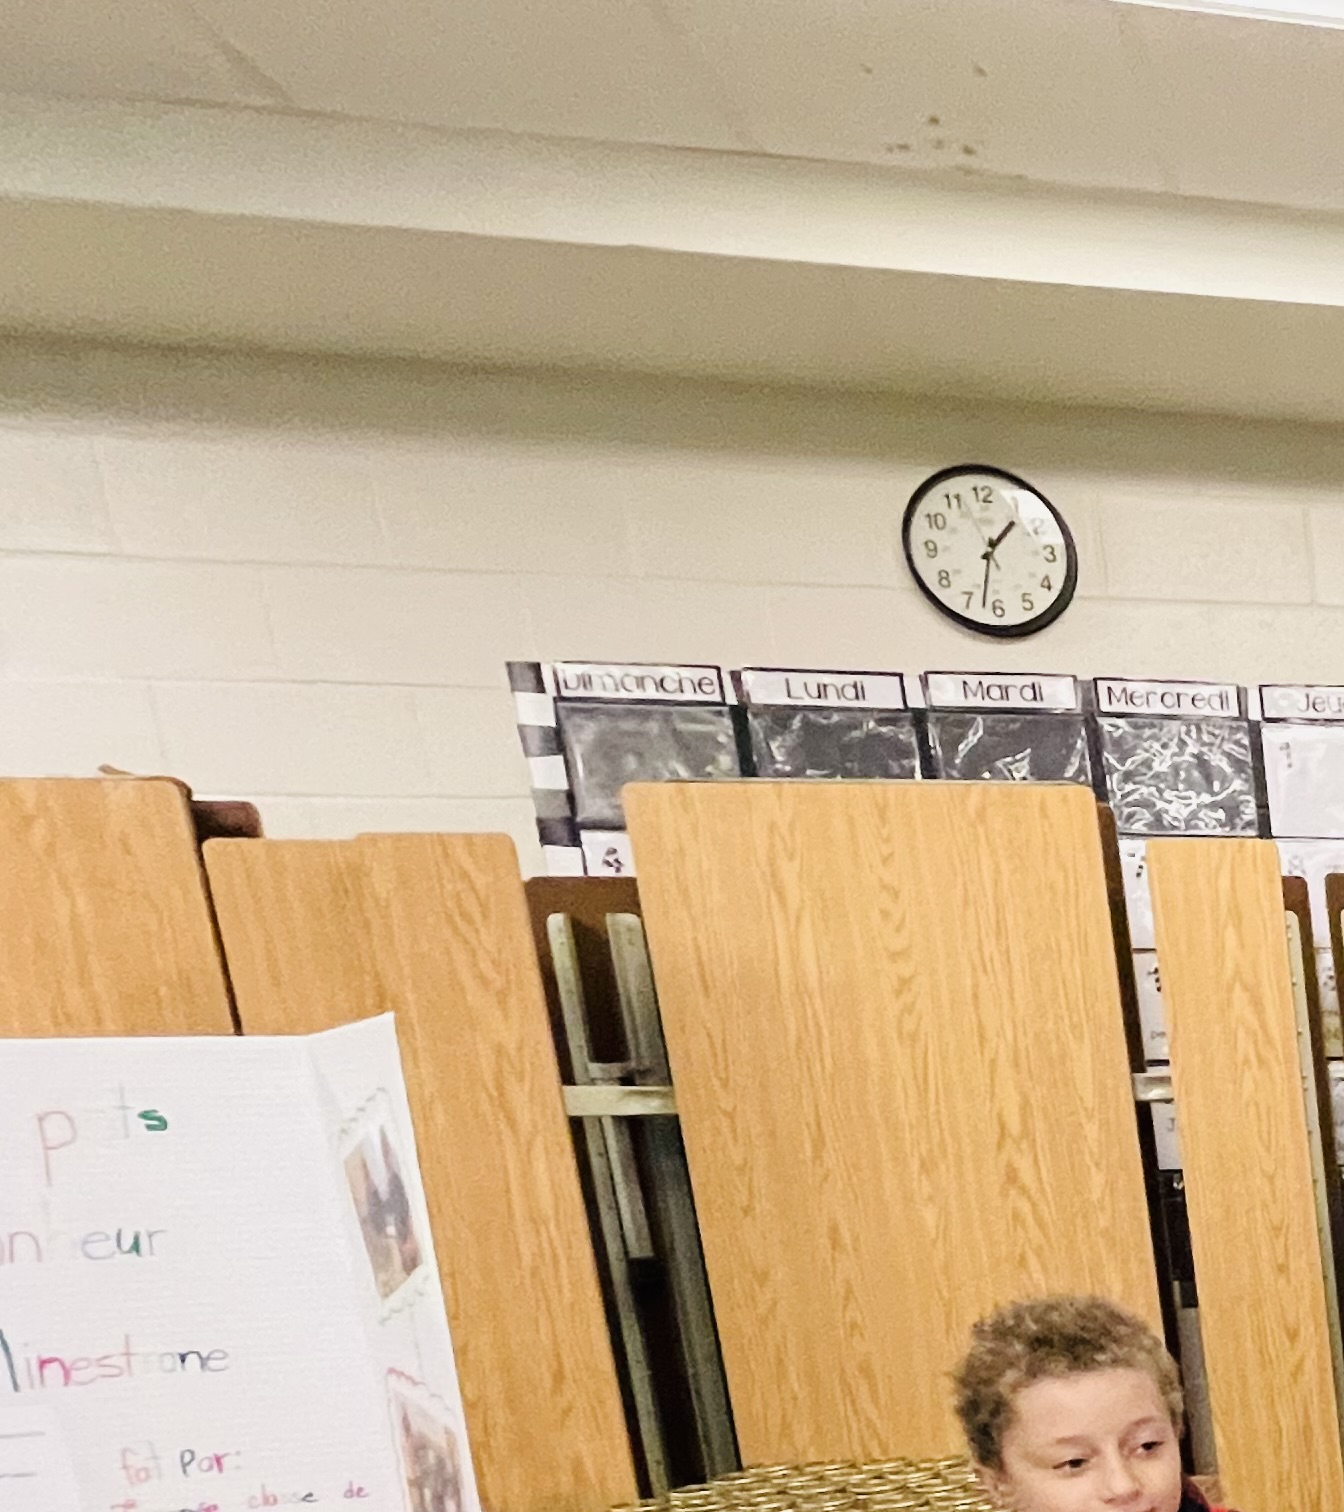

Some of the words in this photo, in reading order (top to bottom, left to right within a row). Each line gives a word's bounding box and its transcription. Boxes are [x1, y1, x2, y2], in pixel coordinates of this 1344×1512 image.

[943, 493, 962, 510] 11
[972, 485, 993, 503] 12
[924, 512, 947, 530] 10
[923, 539, 938, 559] 9
[1042, 544, 1057, 563] 3
[937, 569, 951, 588] 8
[1040, 574, 1053, 591] 4
[961, 591, 974, 609] 7
[991, 599, 1006, 618] 6
[1021, 592, 1034, 611] 5
[785, 677, 866, 701] Lundi
[962, 679, 1044, 702] Mardi
[1106, 685, 1231, 712] Mercredi
[1279, 741, 1293, 768] 1
[343, 1480, 371, 1500] de
